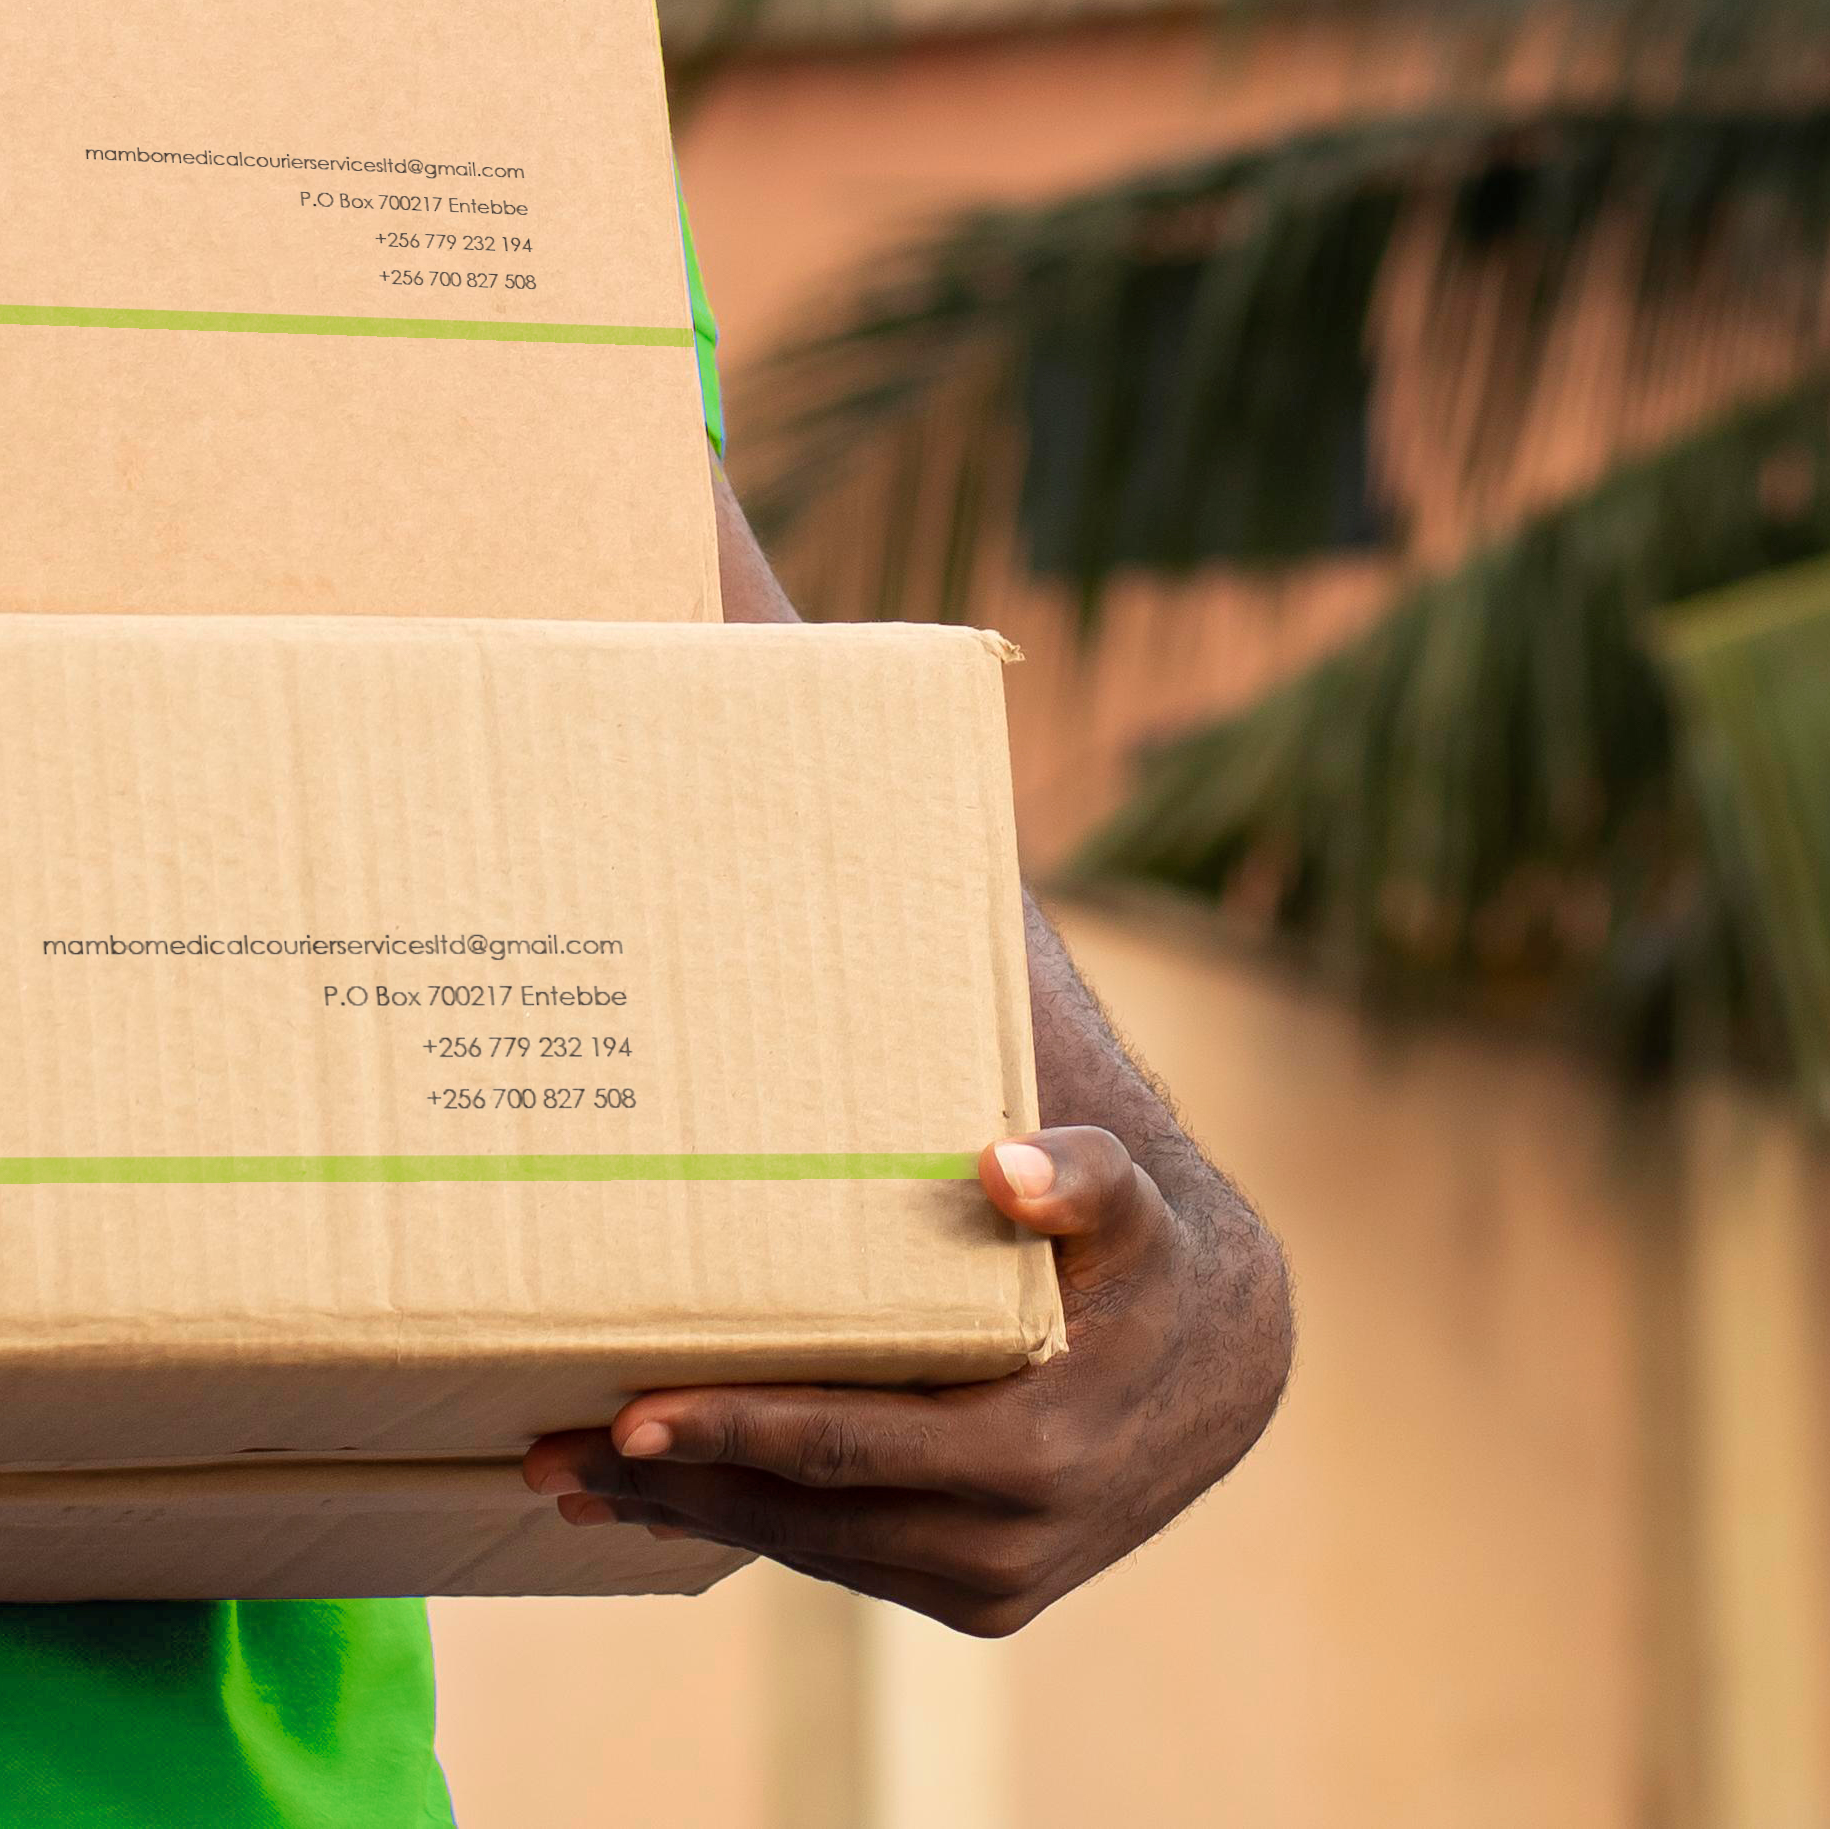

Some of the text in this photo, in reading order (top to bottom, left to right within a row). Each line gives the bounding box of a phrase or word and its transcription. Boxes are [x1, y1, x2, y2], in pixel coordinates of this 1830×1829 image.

[85, 146, 525, 180] mambomedicalcourierservicesltd@gmail.com
[299, 191, 529, 216] P.O Box 700217 Entebbe
[374, 232, 534, 253] +256 779 232 194
[378, 269, 537, 290] +256 700 827 508
[42, 933, 624, 961] mambomedicalcourierservicesltd@gmail.com
[323, 985, 628, 1007] P.O Box 700217 Entebbe
[422, 1036, 633, 1058] +256 779 232 194
[426, 1087, 637, 1110] +256 700 827 508
